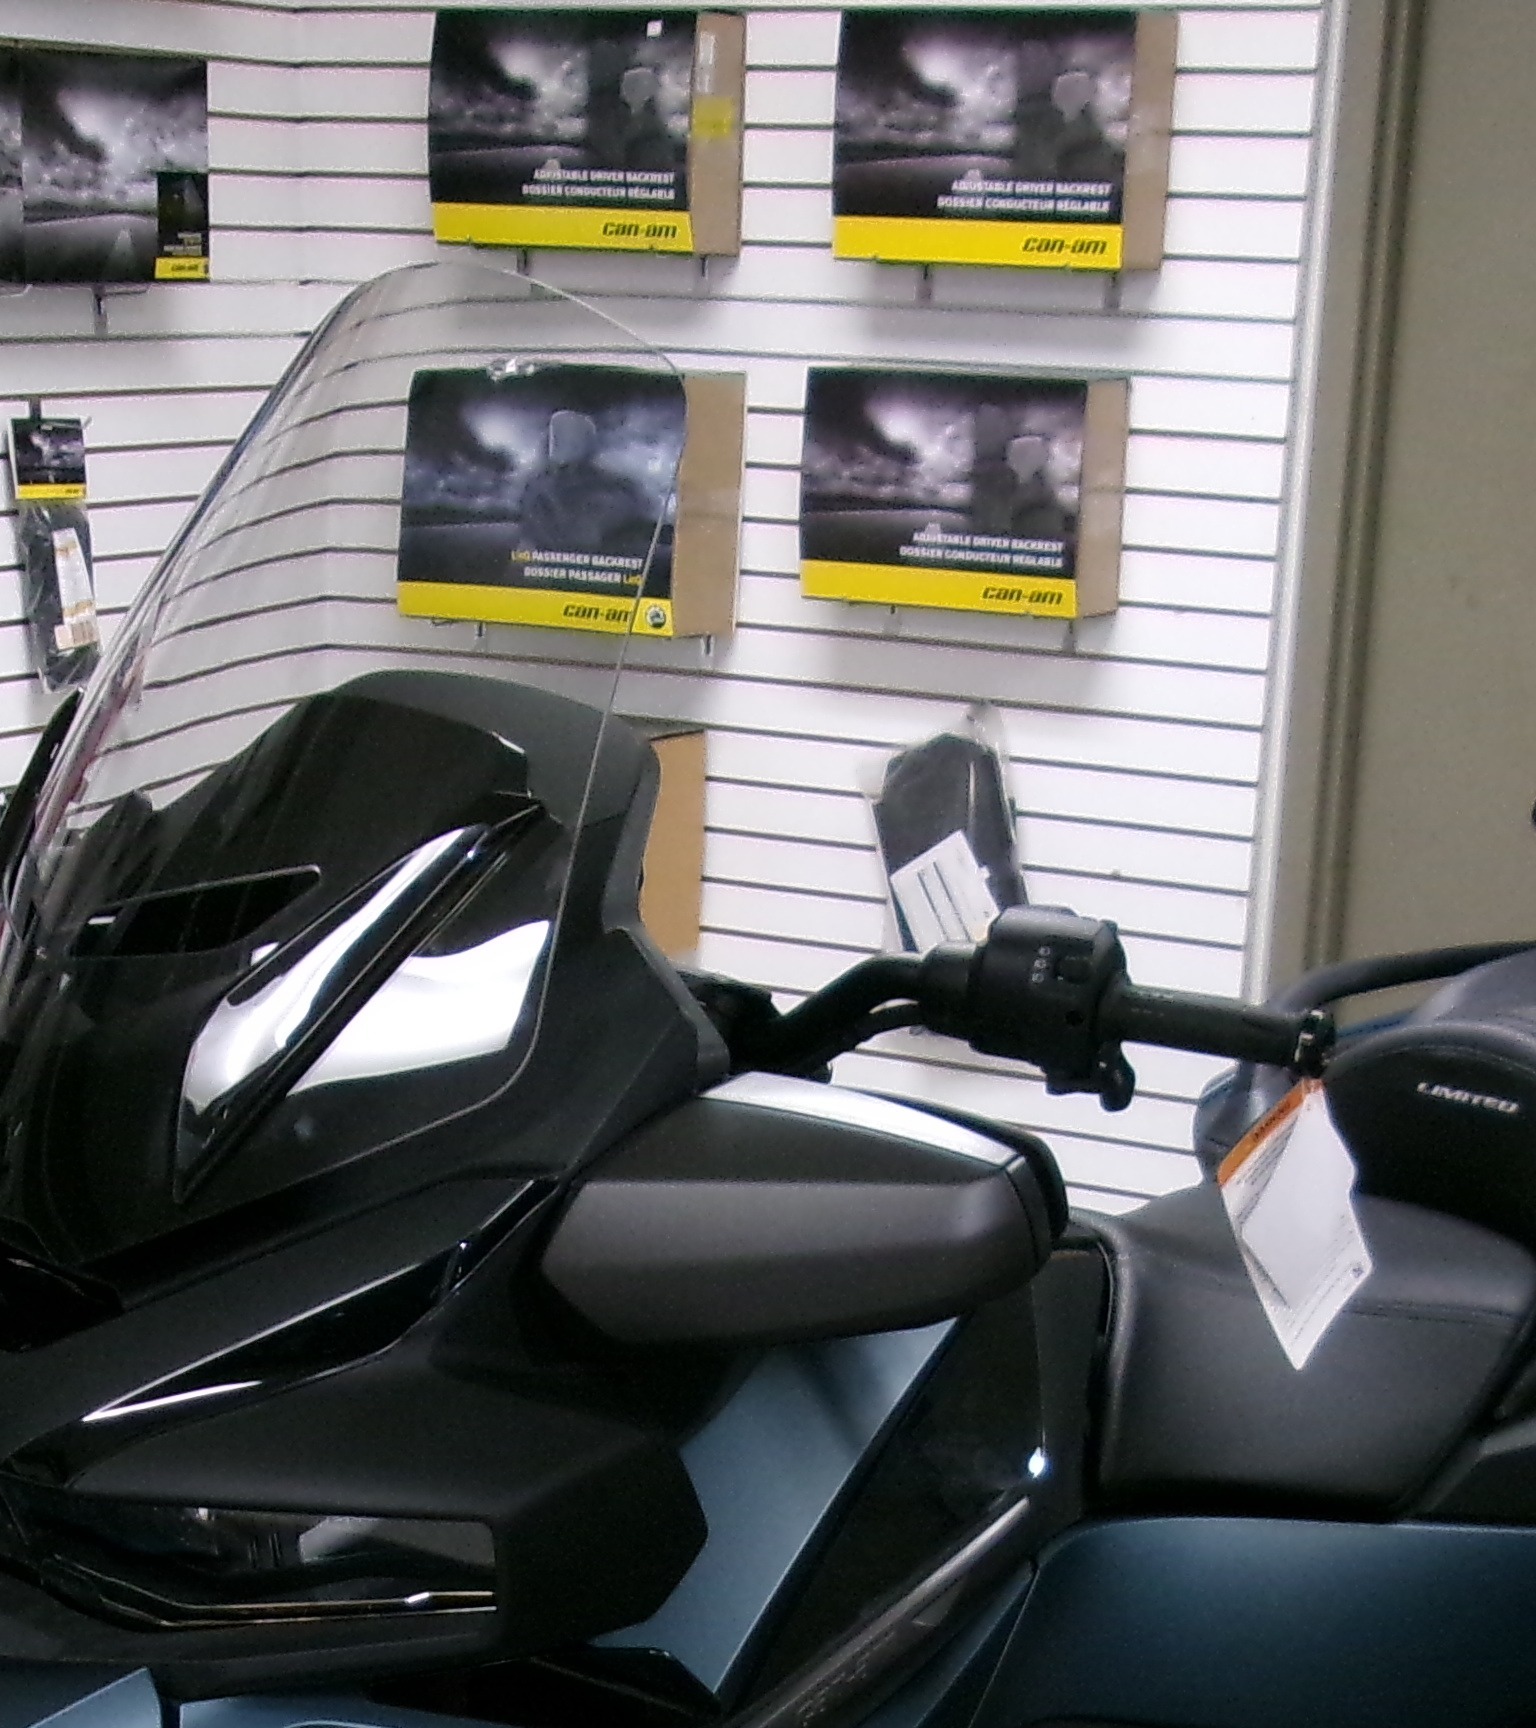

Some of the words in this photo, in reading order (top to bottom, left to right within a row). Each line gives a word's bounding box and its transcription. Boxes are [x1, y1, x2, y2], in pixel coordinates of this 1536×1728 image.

[590, 170, 624, 182] DRIVER
[626, 171, 675, 184] BACKREST
[1056, 182, 1112, 195] BACKREST
[602, 222, 677, 238] can-am
[1022, 237, 1107, 255] can-am
[592, 555, 643, 570] BACKREST
[982, 586, 1063, 605] can-am
[1417, 1081, 1520, 1114] LIMITED
